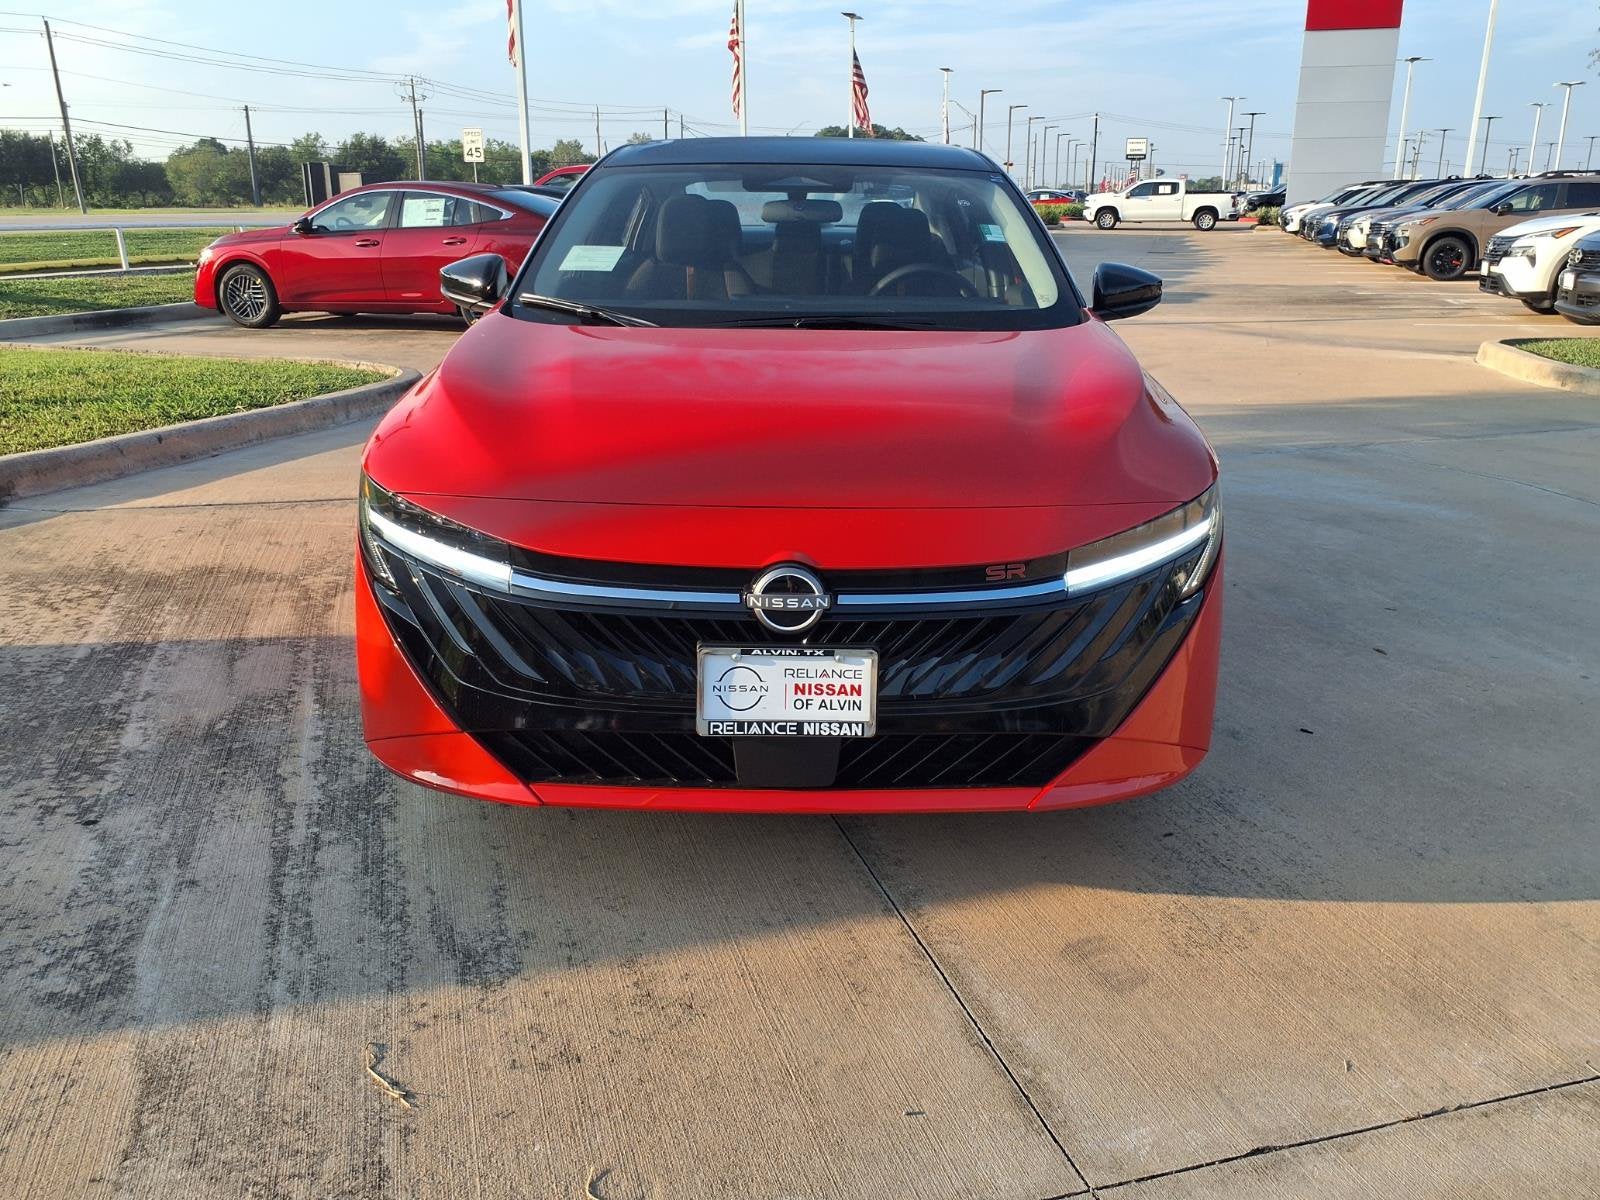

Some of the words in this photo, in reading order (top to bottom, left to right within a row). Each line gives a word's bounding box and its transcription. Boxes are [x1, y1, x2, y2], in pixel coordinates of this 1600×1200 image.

[466, 147, 482, 158] 45
[985, 563, 1026, 581] SR
[749, 596, 829, 608] NISSAN
[784, 668, 863, 680] RELIANCE
[712, 685, 769, 693] NISSAN
[794, 683, 862, 697] NISSAN
[793, 698, 814, 711] OF
[818, 699, 862, 711] ALVIN
[709, 722, 798, 735] RELIANCE
[803, 722, 863, 736] NISSAN
